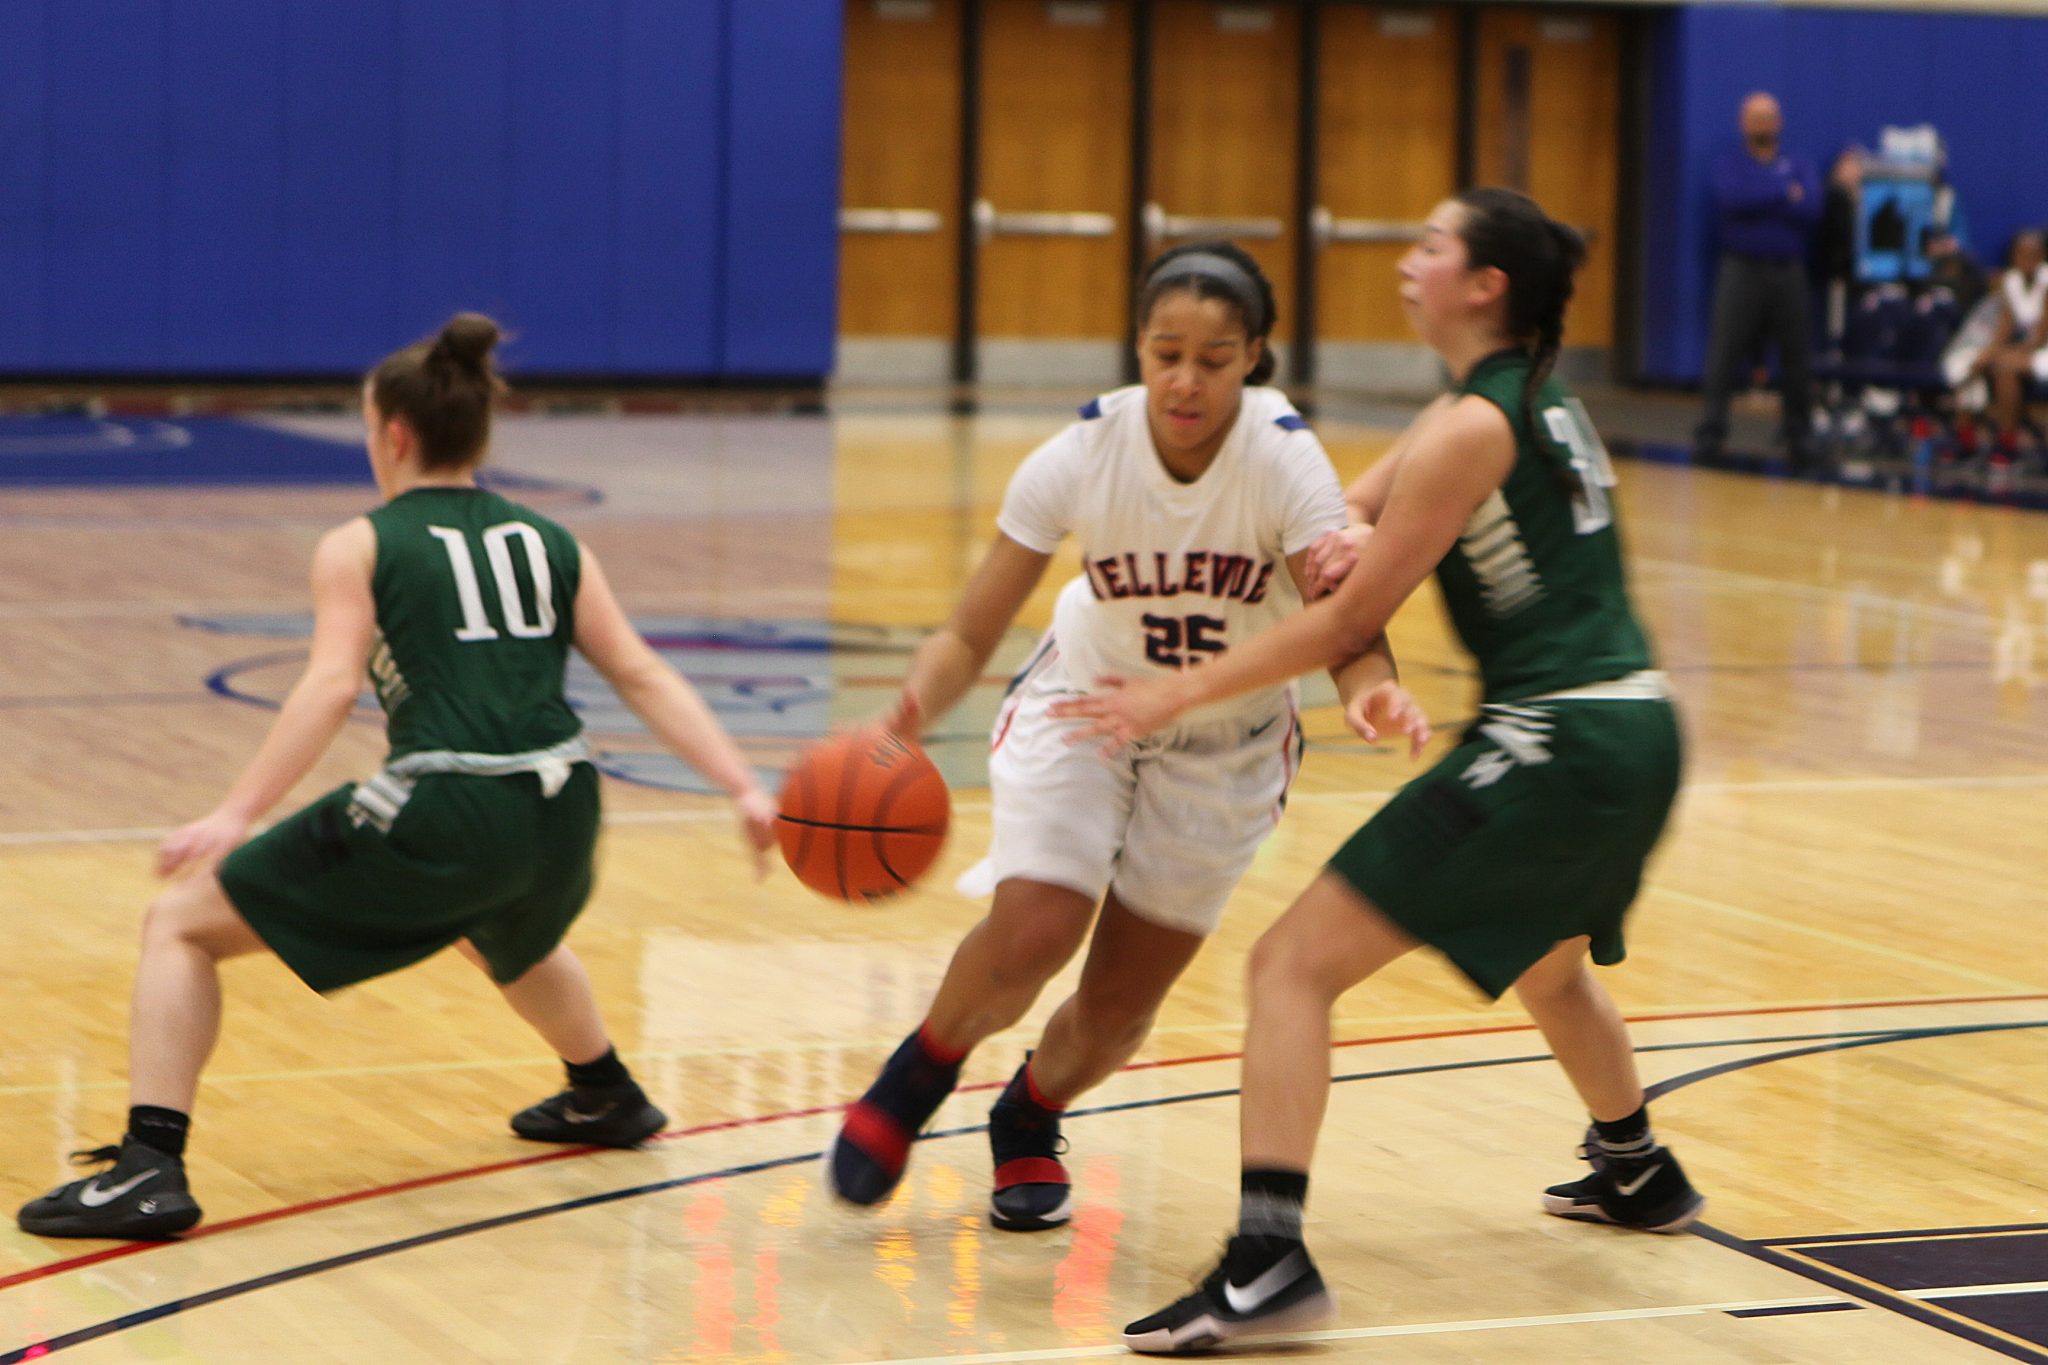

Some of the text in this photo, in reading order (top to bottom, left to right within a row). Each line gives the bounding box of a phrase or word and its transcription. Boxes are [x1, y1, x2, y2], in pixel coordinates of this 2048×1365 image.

[427, 520, 557, 642] 10
[1085, 550, 1275, 605] ELLEVUE
[1142, 612, 1228, 669] 25
